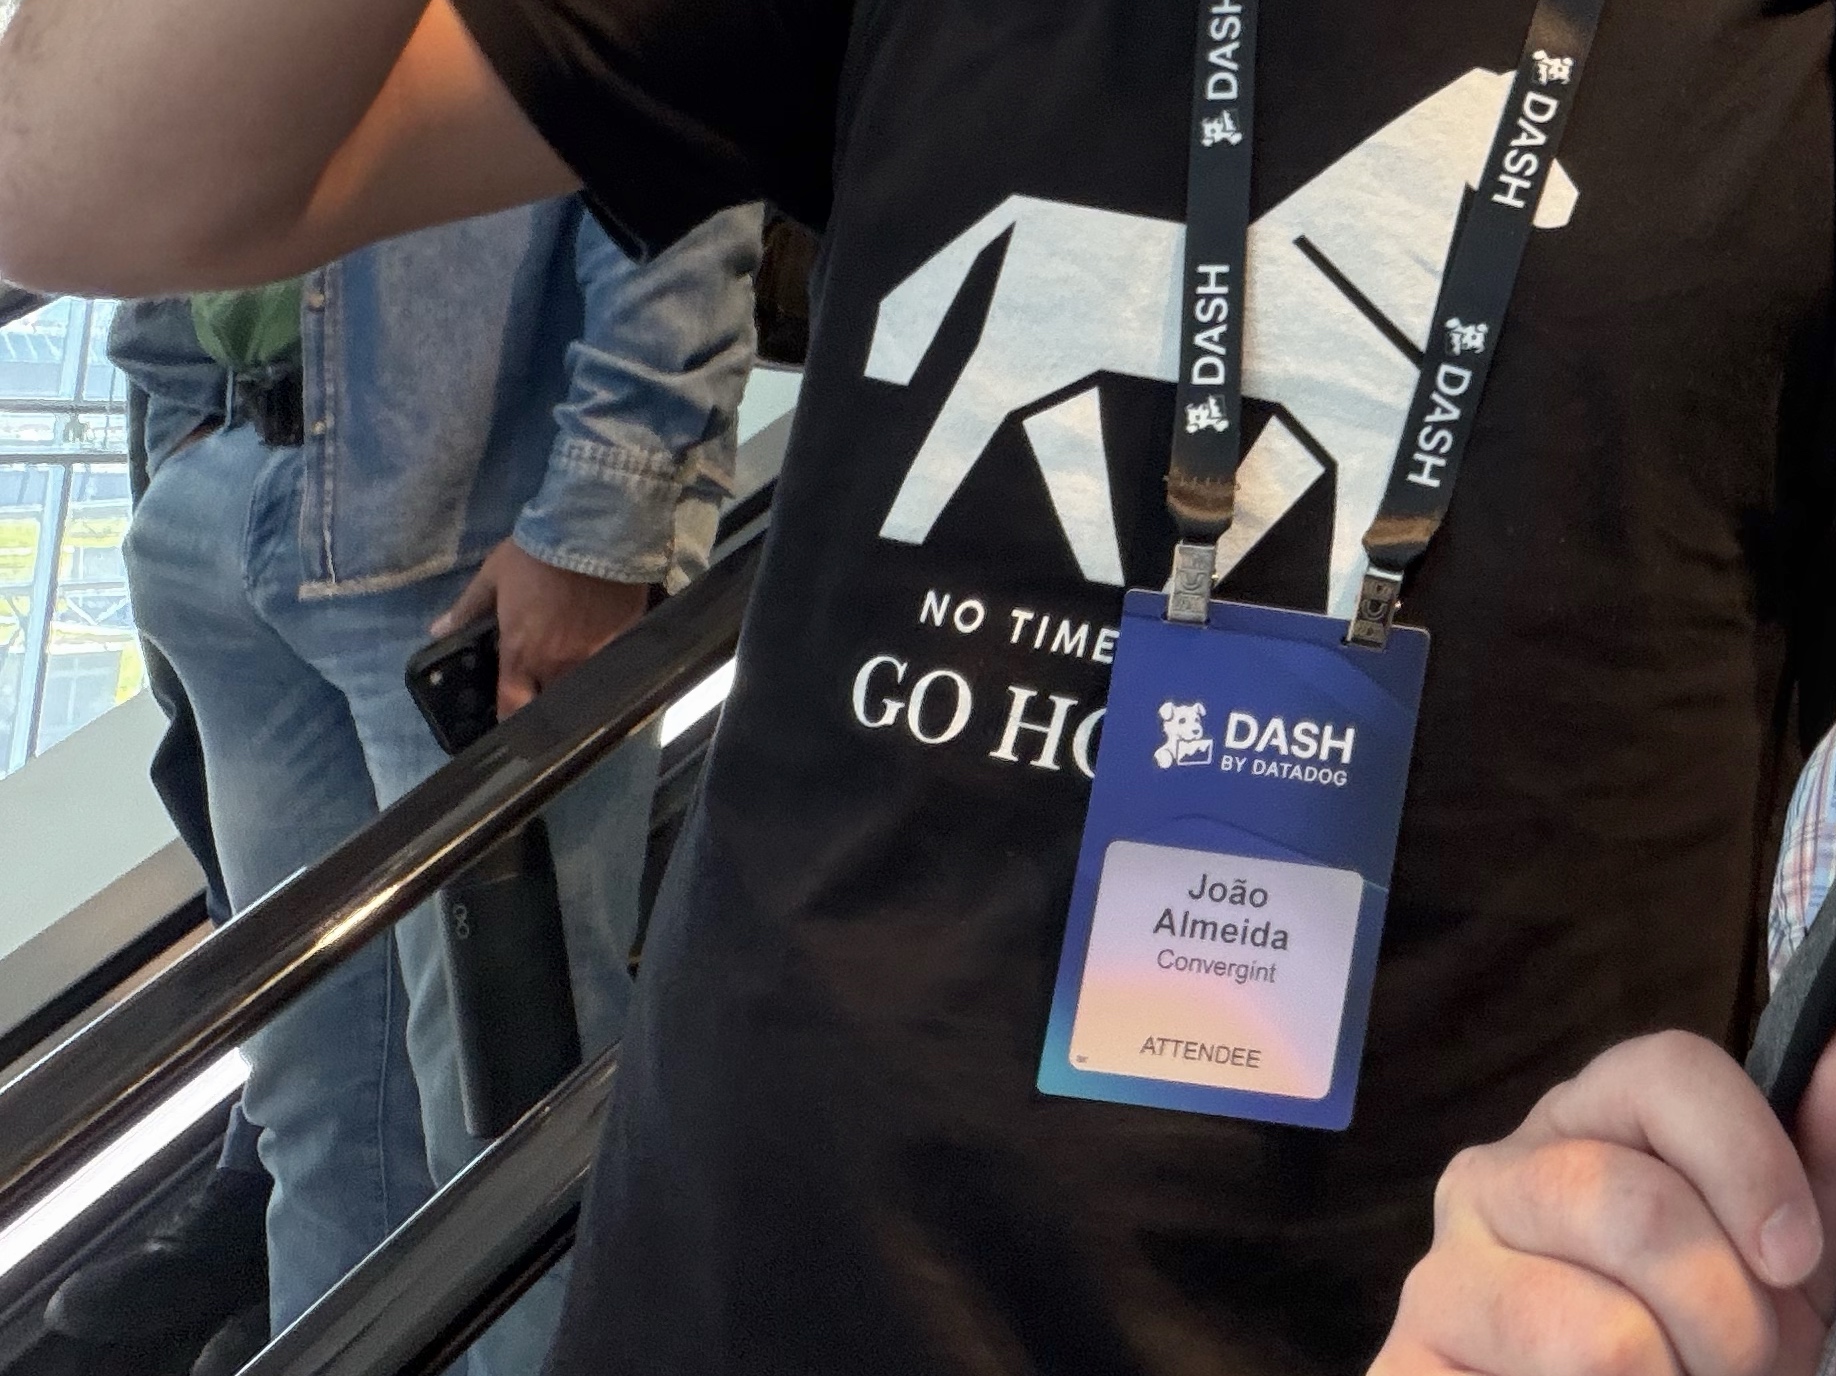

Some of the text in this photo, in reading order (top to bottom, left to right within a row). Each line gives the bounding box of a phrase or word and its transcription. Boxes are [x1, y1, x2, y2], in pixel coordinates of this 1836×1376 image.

[1492, 92, 1557, 208] DASH
[1192, 265, 1229, 384] DASH
[1408, 364, 1471, 487] DASH
[920, 590, 1120, 664] NO TIME
[853, 656, 973, 744] GO
[1225, 712, 1355, 763] DASH
[1221, 755, 1347, 787] BY DATADOG
[1189, 873, 1268, 908] João
[1153, 908, 1289, 951] Almeida
[1156, 948, 1277, 985] Convergint
[1140, 1036, 1262, 1068] ATTENDEE
